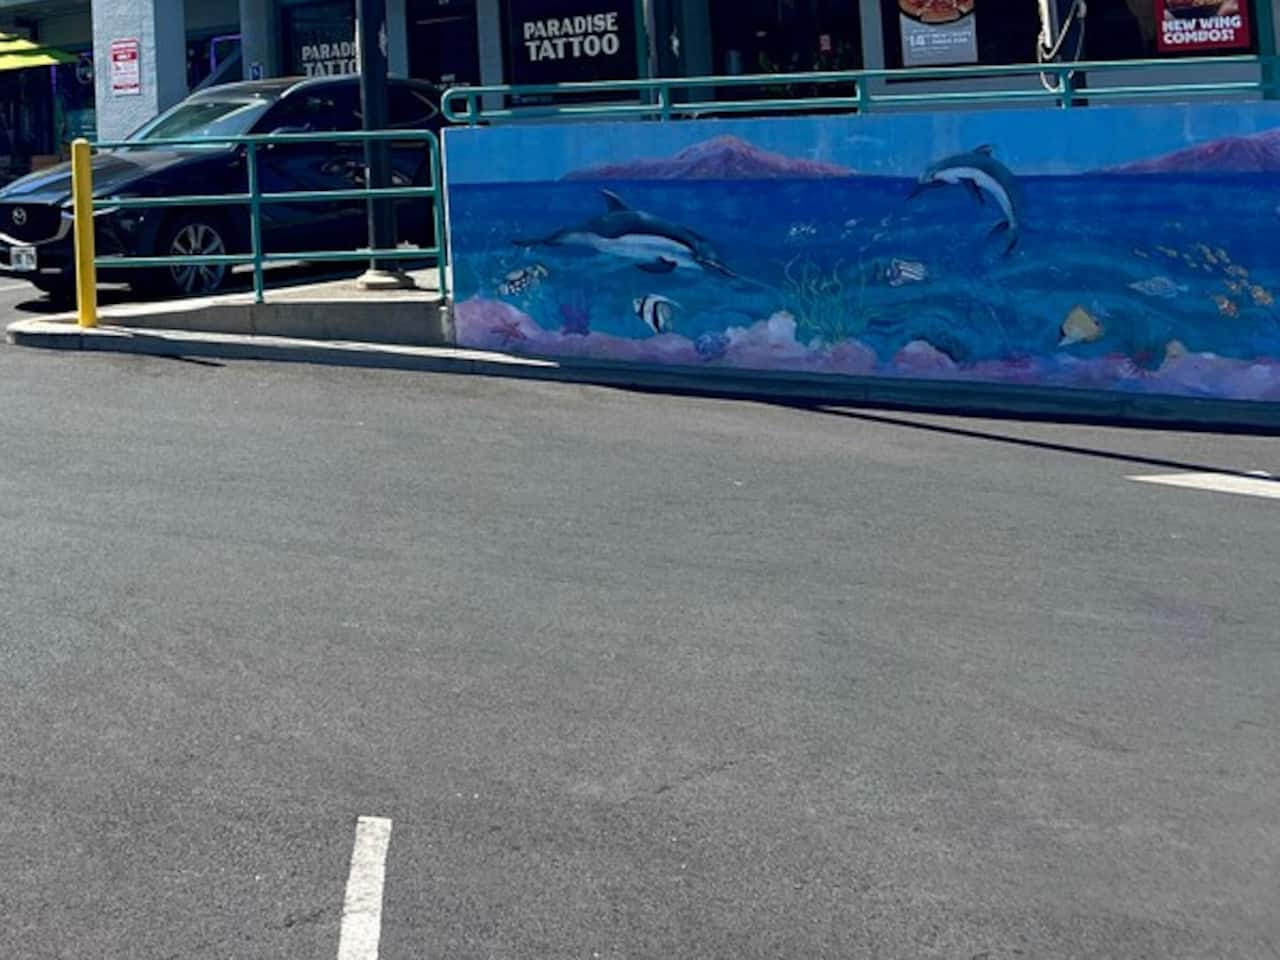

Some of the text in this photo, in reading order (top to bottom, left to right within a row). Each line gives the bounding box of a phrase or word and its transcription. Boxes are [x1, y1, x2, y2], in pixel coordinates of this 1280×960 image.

[523, 12, 619, 40] PARADISE
[1162, 14, 1242, 33] NEW WING
[301, 41, 358, 61] PARADI
[524, 32, 620, 62] TATTOO
[303, 58, 359, 79] TATTO
